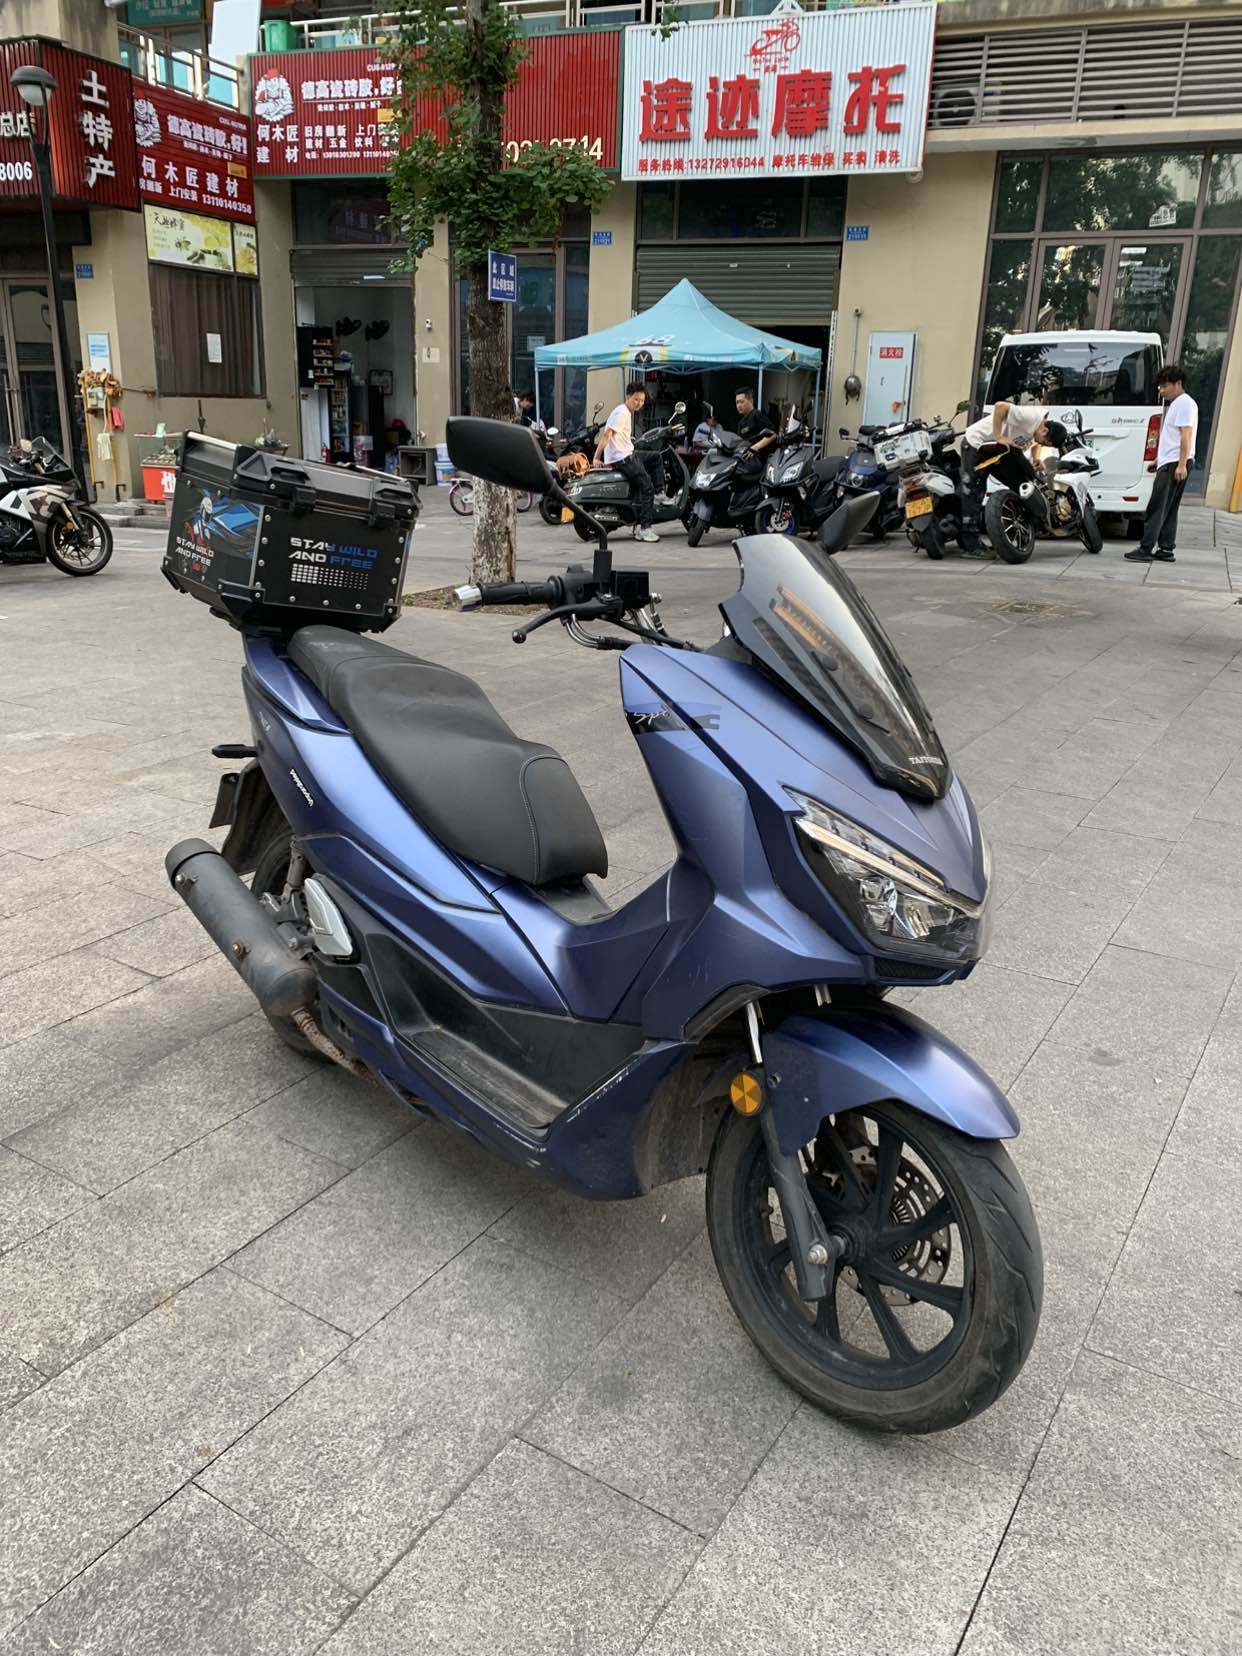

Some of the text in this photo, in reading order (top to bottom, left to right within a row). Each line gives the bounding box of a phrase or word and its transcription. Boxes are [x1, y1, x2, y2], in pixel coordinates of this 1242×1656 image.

[639, 64, 907, 144] 途迹摩托
[80, 69, 116, 189] 土特产
[257, 124, 300, 142] 何木匠
[329, 138, 347, 149] 五金
[256, 145, 300, 163] 建材
[772, 151, 835, 168] 摩托车维保
[0, 160, 33, 181] 8006
[142, 155, 239, 198] 何木匠建材
[175, 546, 191, 558] AND
[176, 536, 195, 550] STAY
[290, 537, 378, 559] STAY WILD
[288, 550, 327, 563] AND
